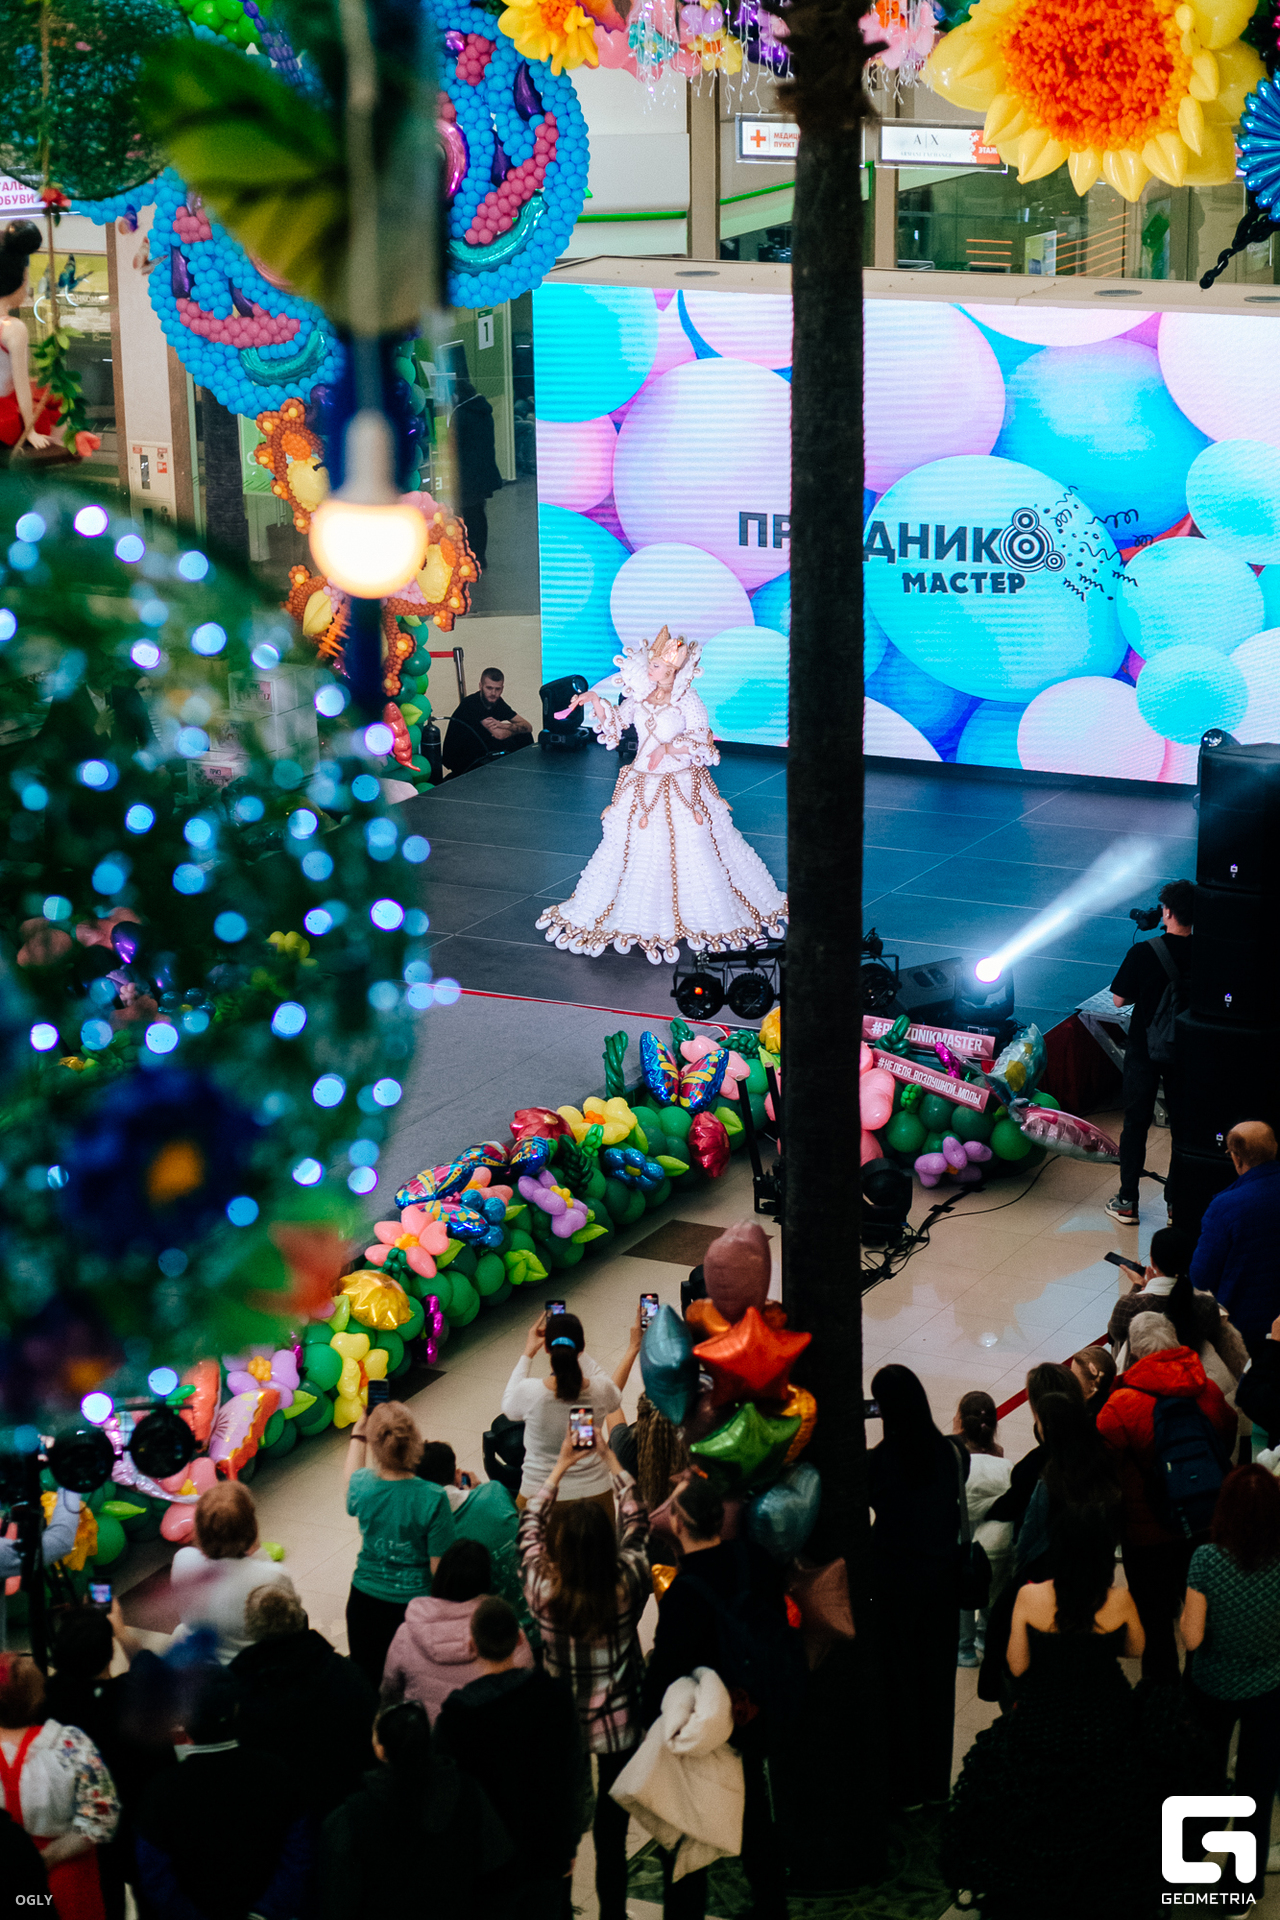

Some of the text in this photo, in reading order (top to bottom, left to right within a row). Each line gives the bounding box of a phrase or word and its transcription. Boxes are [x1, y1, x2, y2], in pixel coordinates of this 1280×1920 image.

[774, 132, 800, 140] МЕДИЦ
[902, 571, 1026, 594] МАСТЕР
[871, 1021, 983, 1052] #PZDNIKMASTER
